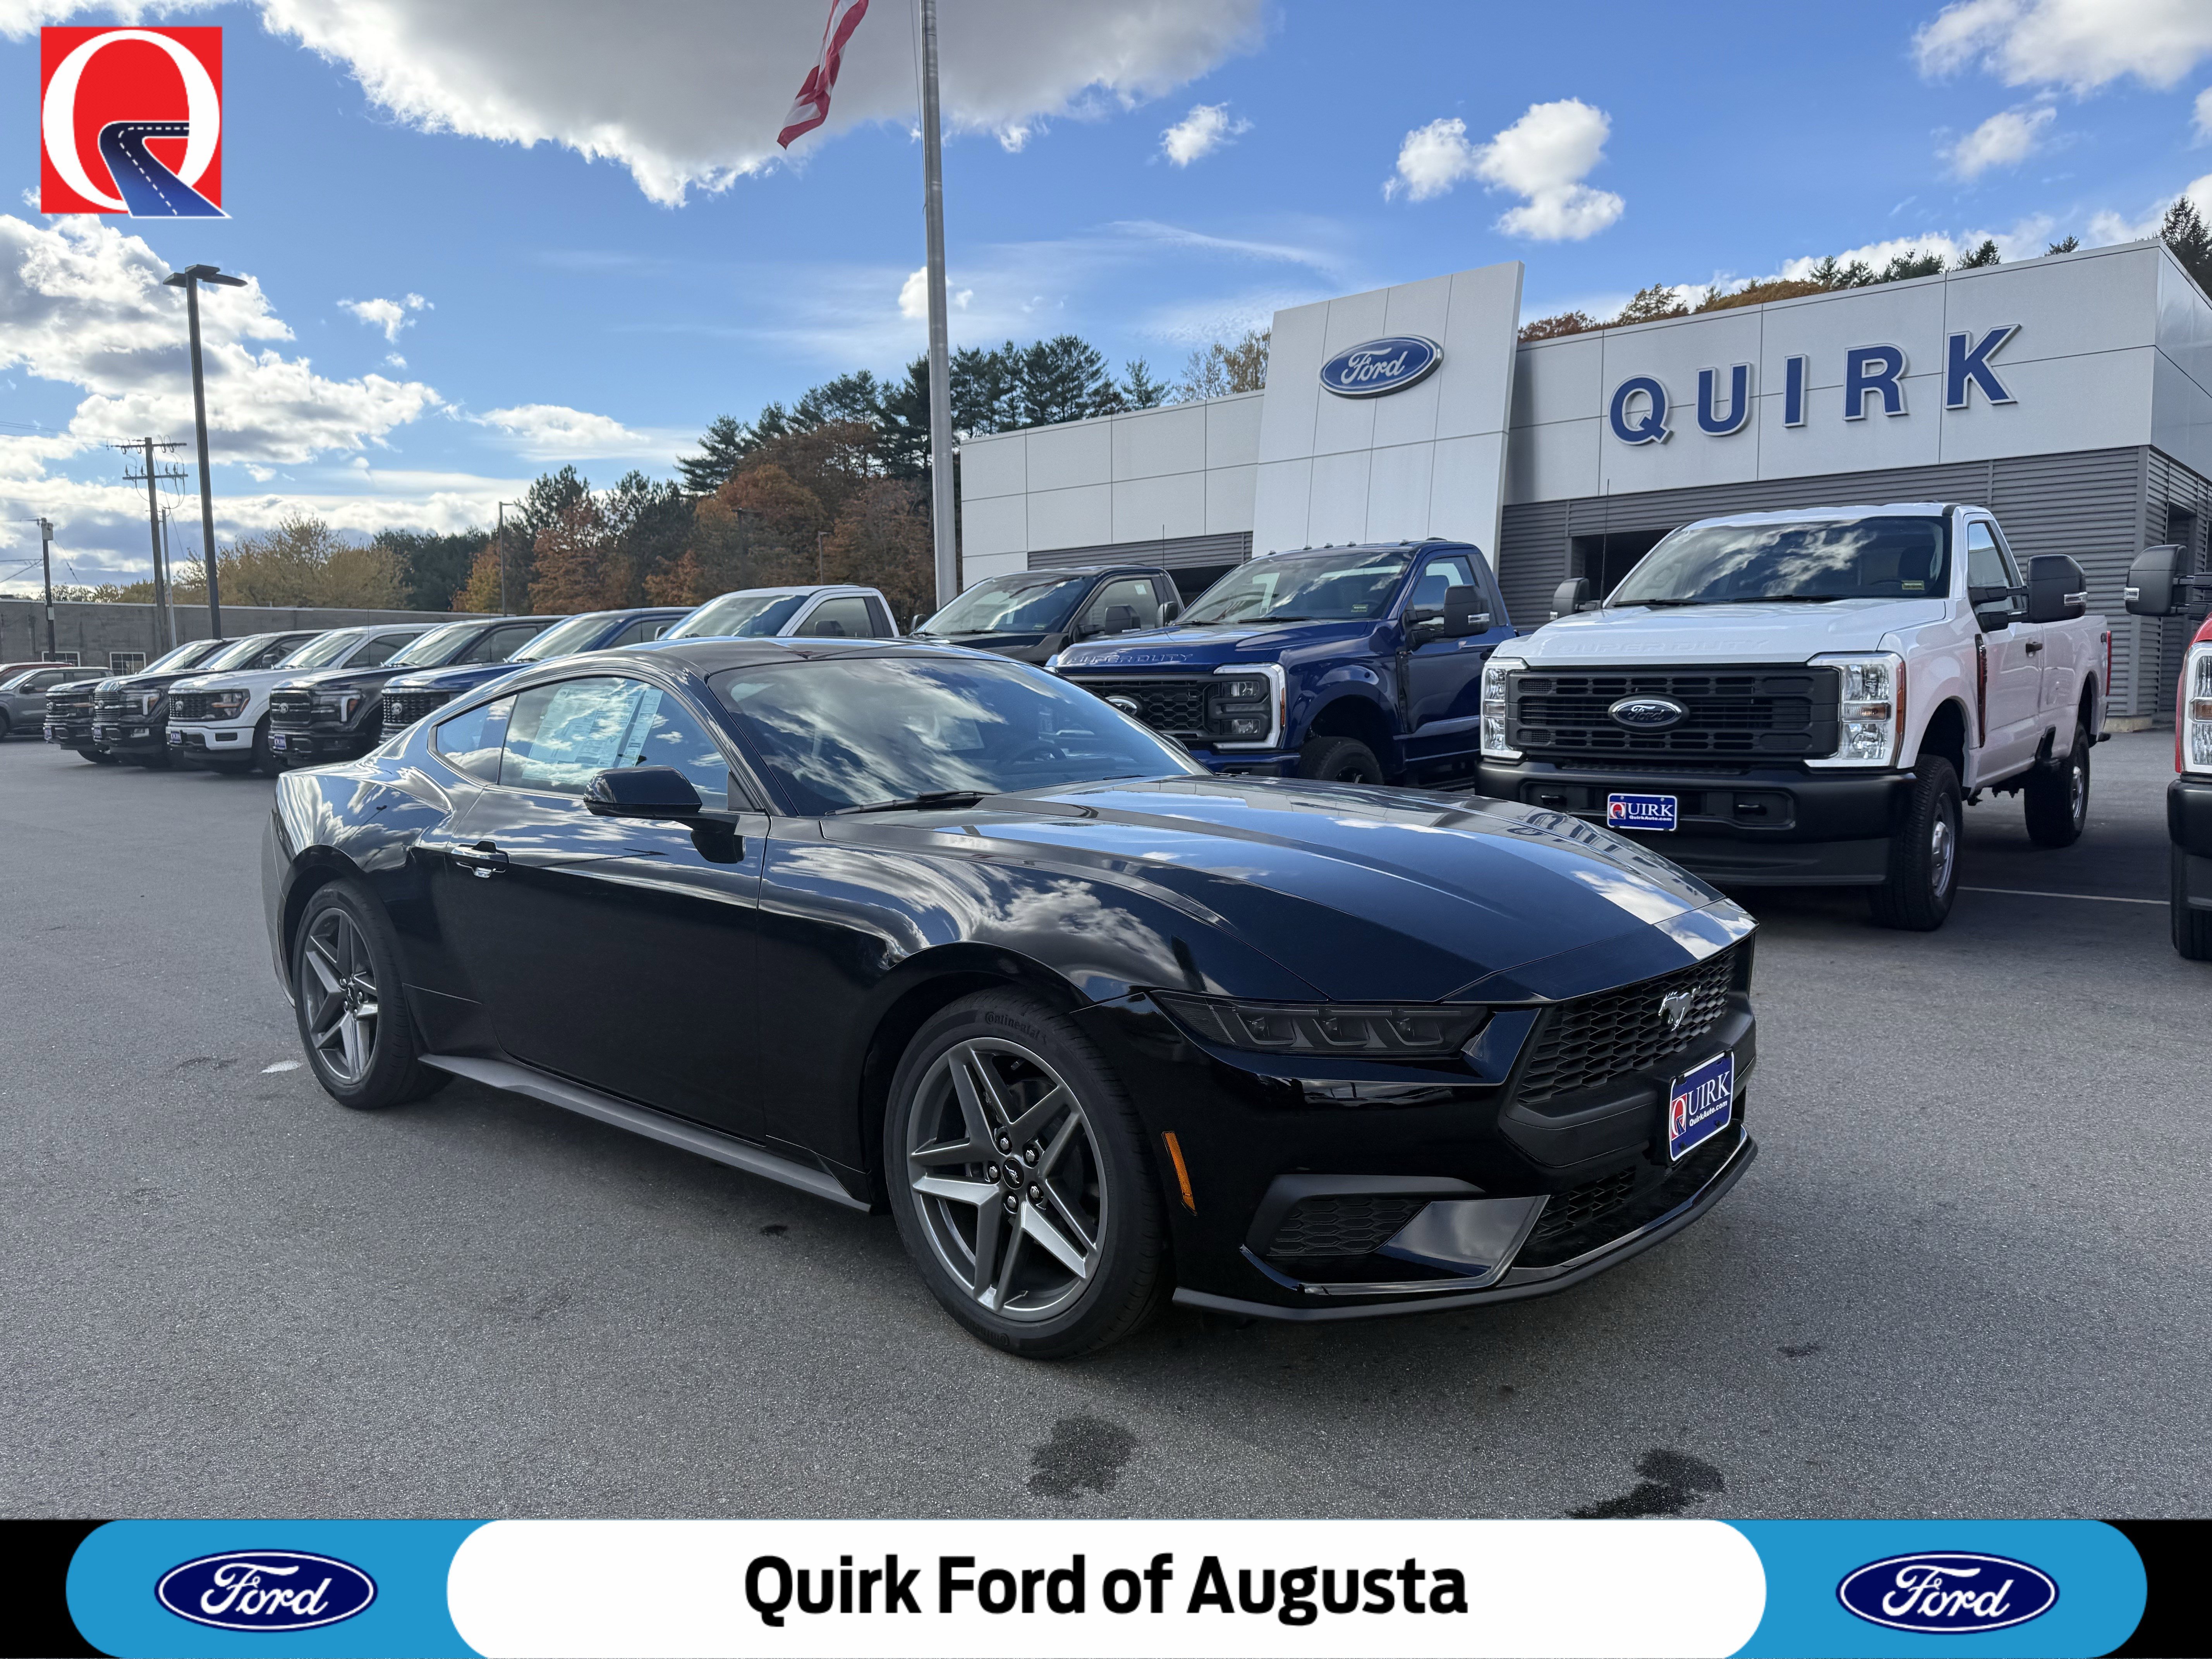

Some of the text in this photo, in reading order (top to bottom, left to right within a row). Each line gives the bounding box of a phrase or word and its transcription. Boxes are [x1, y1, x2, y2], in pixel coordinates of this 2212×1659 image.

[1341, 348, 1408, 384] Ford
[1608, 324, 2021, 446] QUIRK
[1558, 639, 1769, 653] SUPER DUTY
[1628, 705, 1665, 721] Ford
[1609, 802, 1674, 819] QUIRK
[985, 1011, 1041, 1040] Continental
[1672, 1071, 1731, 1135] QUIRK
[1689, 1101, 1728, 1127] QuirkAuto.com
